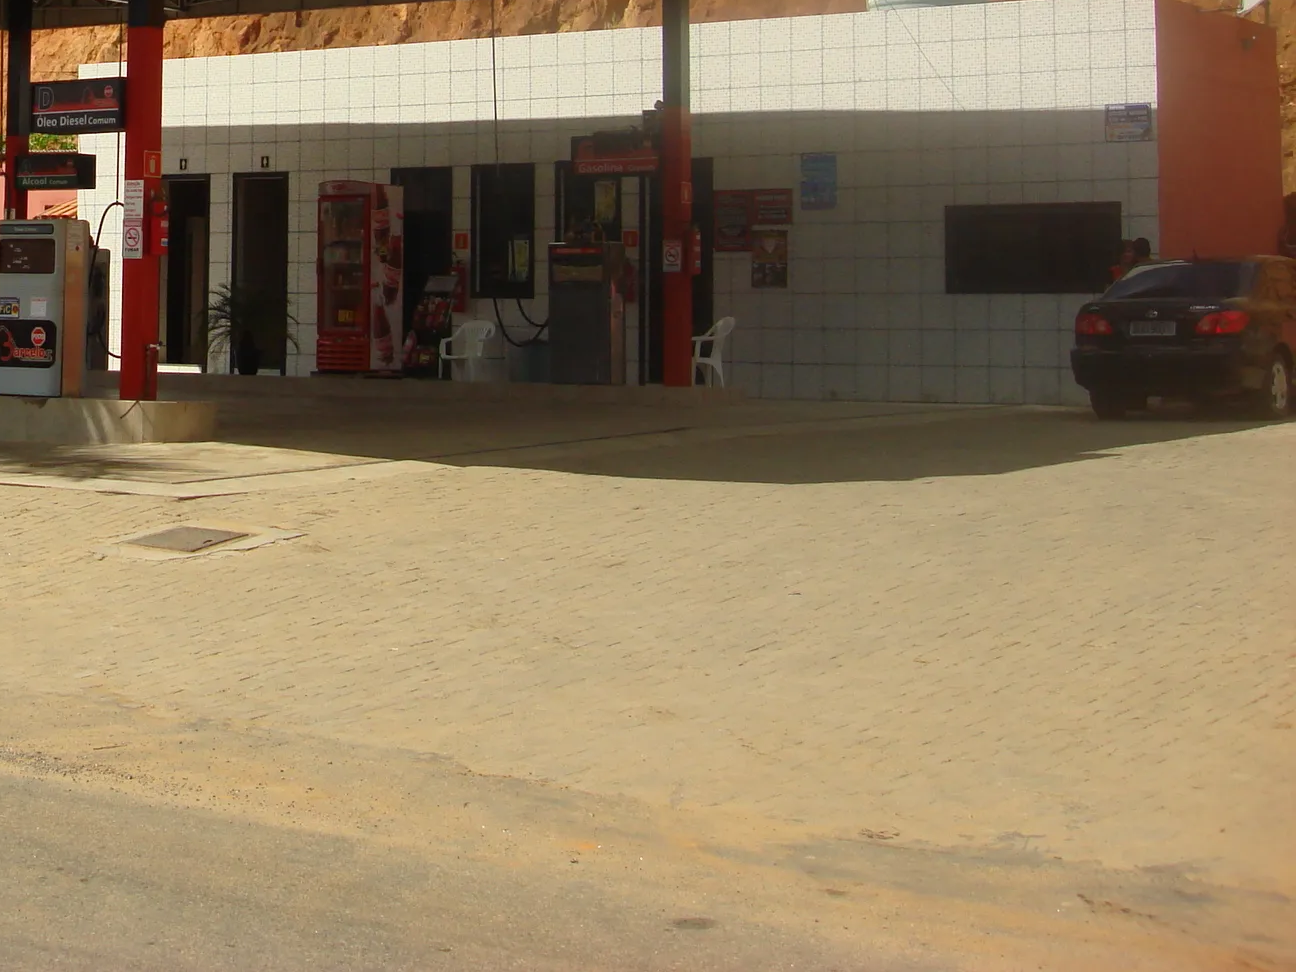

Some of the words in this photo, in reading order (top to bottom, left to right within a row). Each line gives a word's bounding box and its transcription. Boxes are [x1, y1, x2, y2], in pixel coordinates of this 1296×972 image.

[36, 114, 57, 127] Óleo
[59, 114, 87, 126] Diesel
[88, 116, 116, 125] Comum
[578, 163, 624, 173] Gasolina
